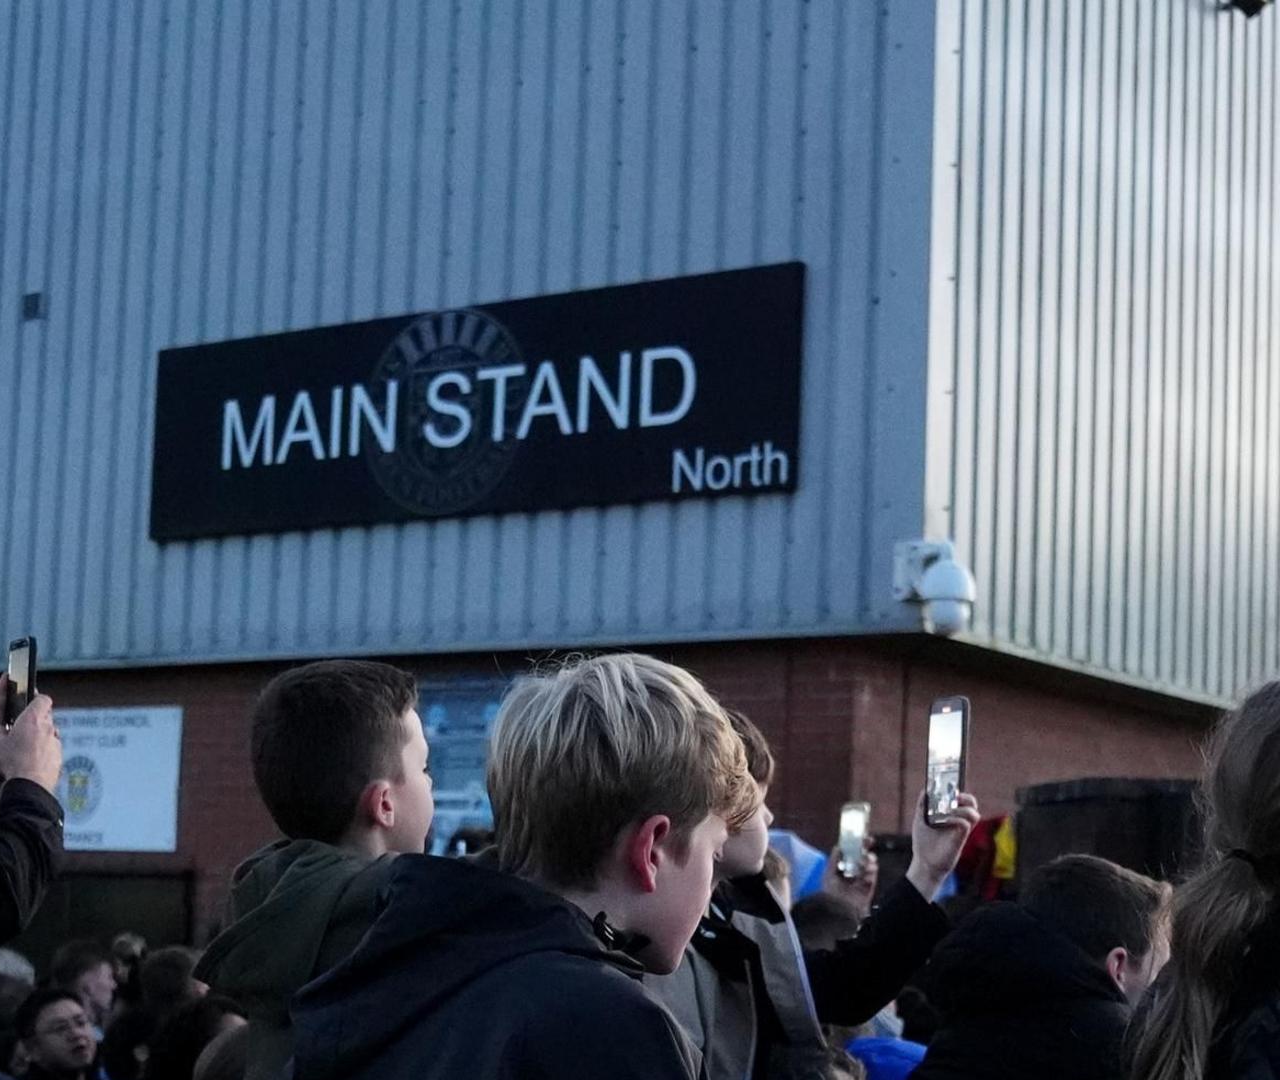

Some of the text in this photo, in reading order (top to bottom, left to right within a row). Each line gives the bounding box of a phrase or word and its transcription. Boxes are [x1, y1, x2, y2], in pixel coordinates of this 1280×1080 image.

[222, 347, 696, 470] MAIN STAND
[672, 442, 788, 493] North
